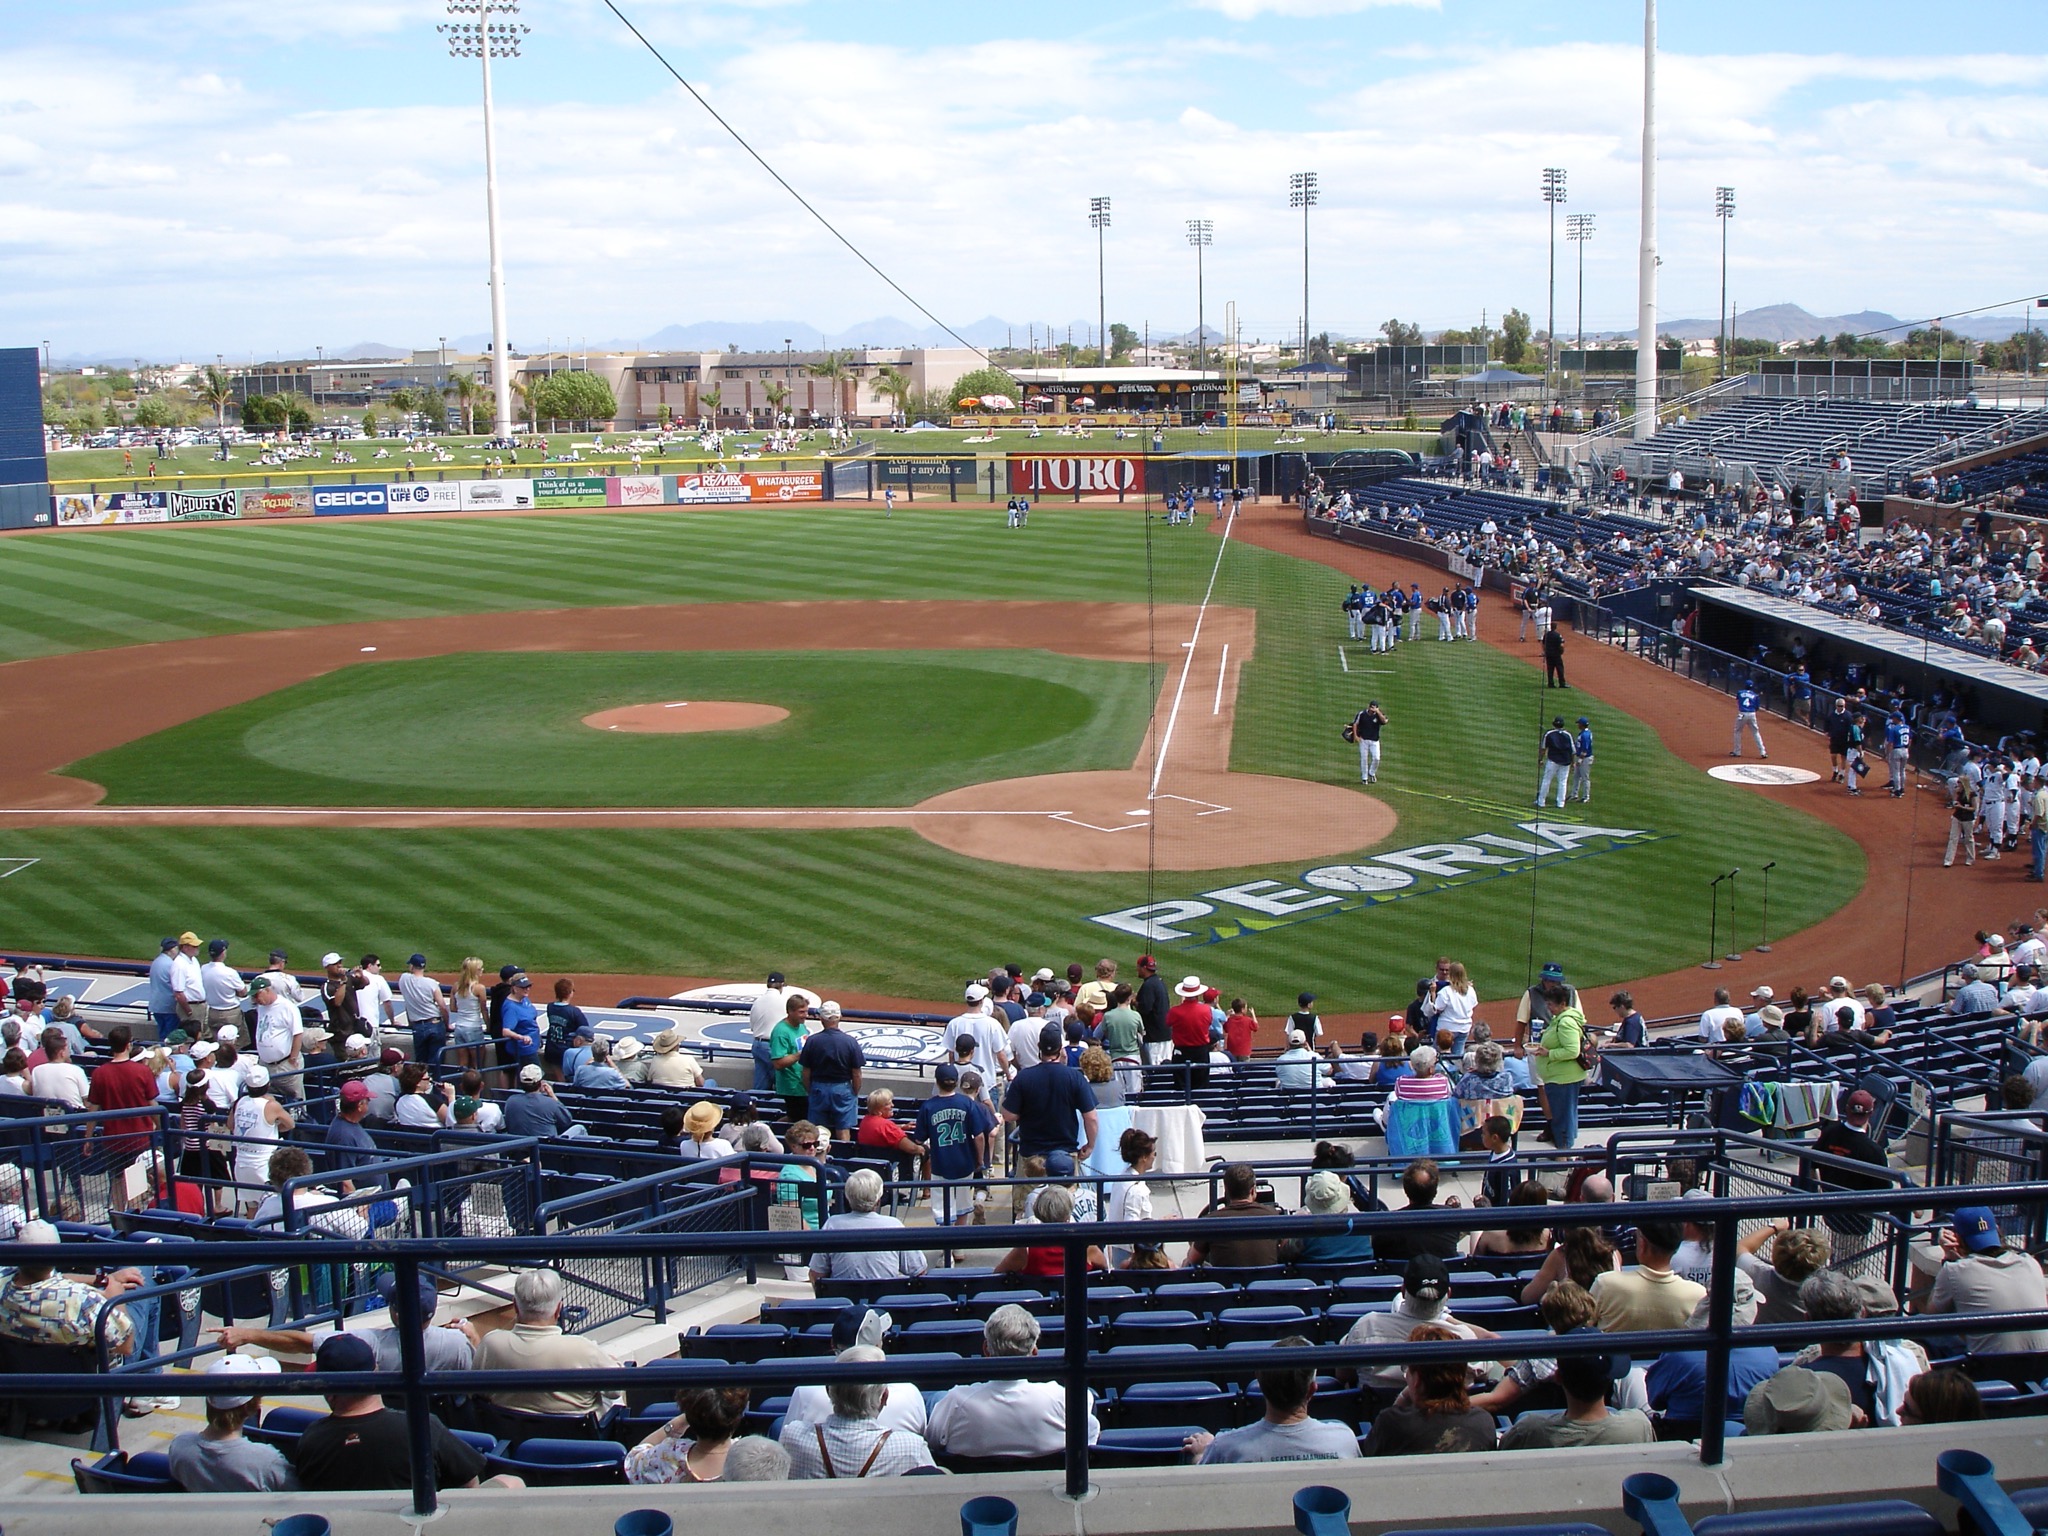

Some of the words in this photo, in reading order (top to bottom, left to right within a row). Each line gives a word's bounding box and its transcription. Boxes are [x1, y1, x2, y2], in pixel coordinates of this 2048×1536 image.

[918, 466, 934, 476] any
[1216, 463, 1230, 472] 340
[543, 469, 556, 477] 385
[1022, 459, 1134, 490] TORO
[703, 474, 743, 486] RE/MAX
[757, 476, 815, 486] WHATABURGER
[415, 489, 429, 500] BE
[433, 492, 457, 500] FREE
[537, 488, 554, 496] your
[554, 487, 569, 495] field
[577, 486, 604, 494] dreams.
[315, 491, 385, 507] GEICO
[390, 493, 411, 502] LIFE
[171, 491, 235, 516] McDUFFY'S
[34, 514, 48, 522] 410
[1742, 697, 1751, 707] 4
[1900, 734, 1910, 745] 19
[1085, 822, 1652, 940] PEORIA
[931, 1108, 967, 1126] GRIFFEY
[937, 1121, 966, 1147] 24
[1302, 1452, 1339, 1460] MARINERS
